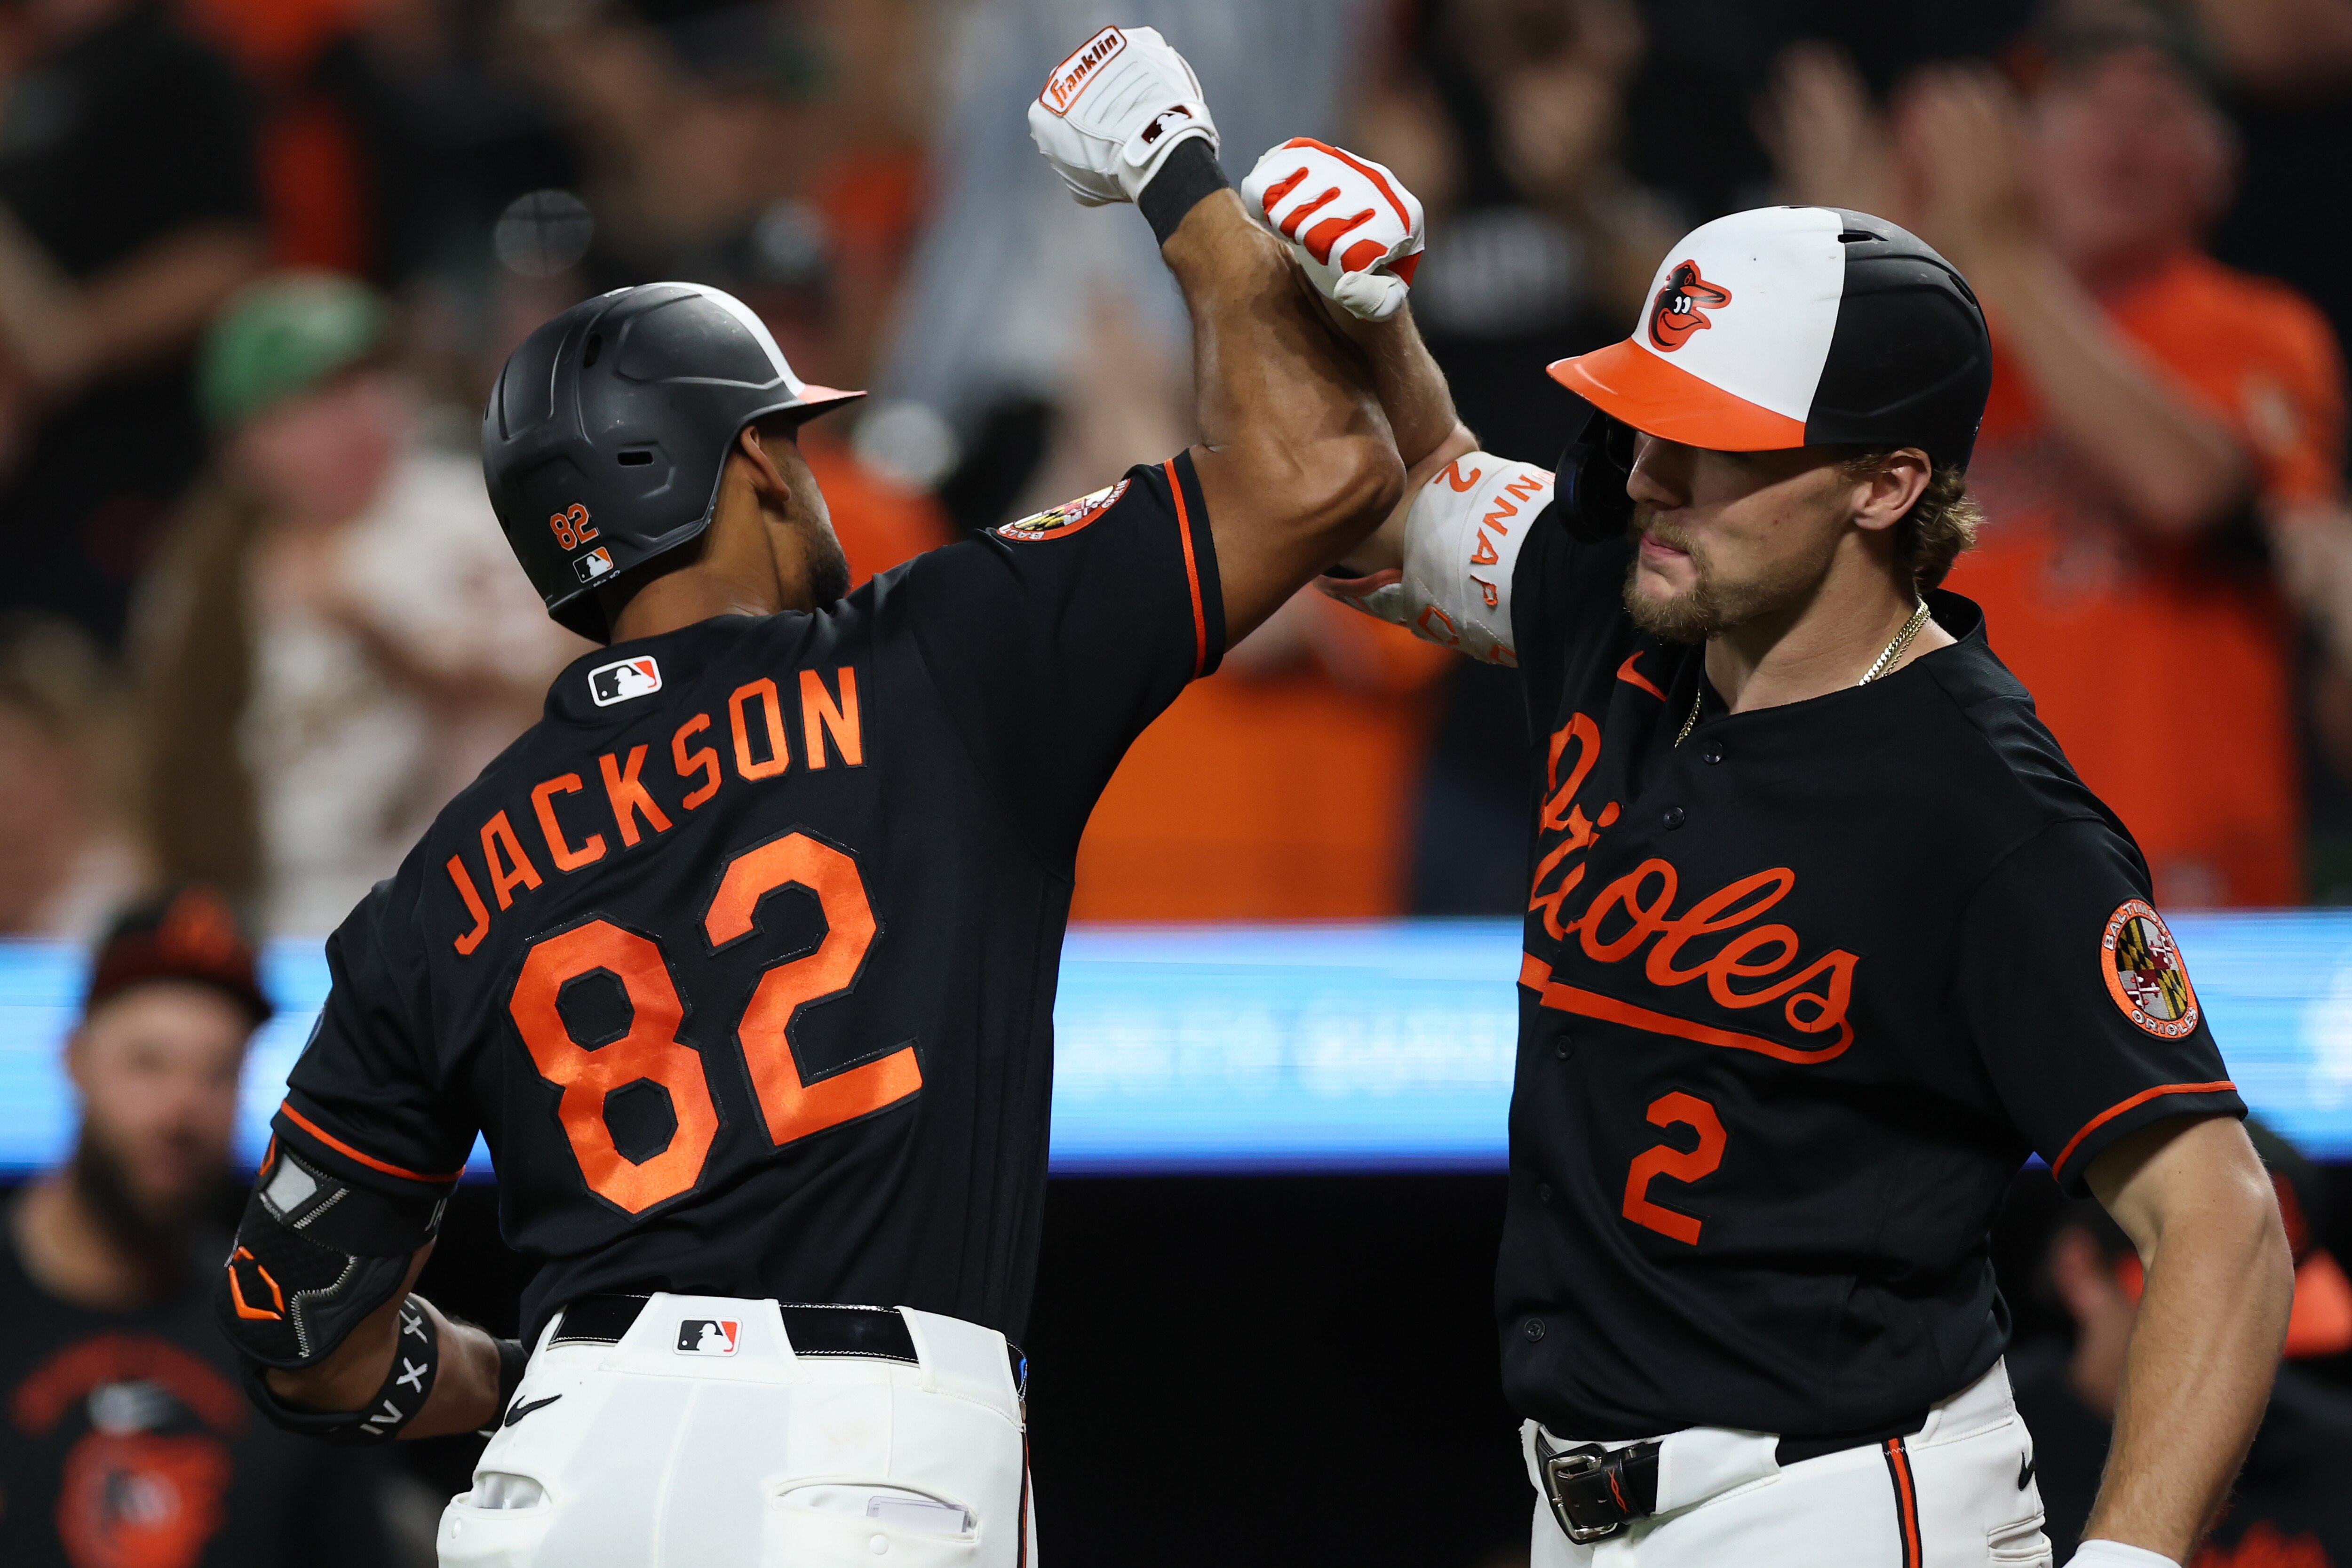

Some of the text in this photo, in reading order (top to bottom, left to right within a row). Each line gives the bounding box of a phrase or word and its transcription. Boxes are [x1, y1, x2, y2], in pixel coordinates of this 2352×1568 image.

[550, 502, 600, 551] 82
[446, 666, 863, 955] JACKSON
[2104, 902, 2176, 950] BALTIMORE
[509, 832, 923, 1215] 82
[2131, 1007, 2198, 1035] ORIOLES
[1623, 1091, 1727, 1245] 2
